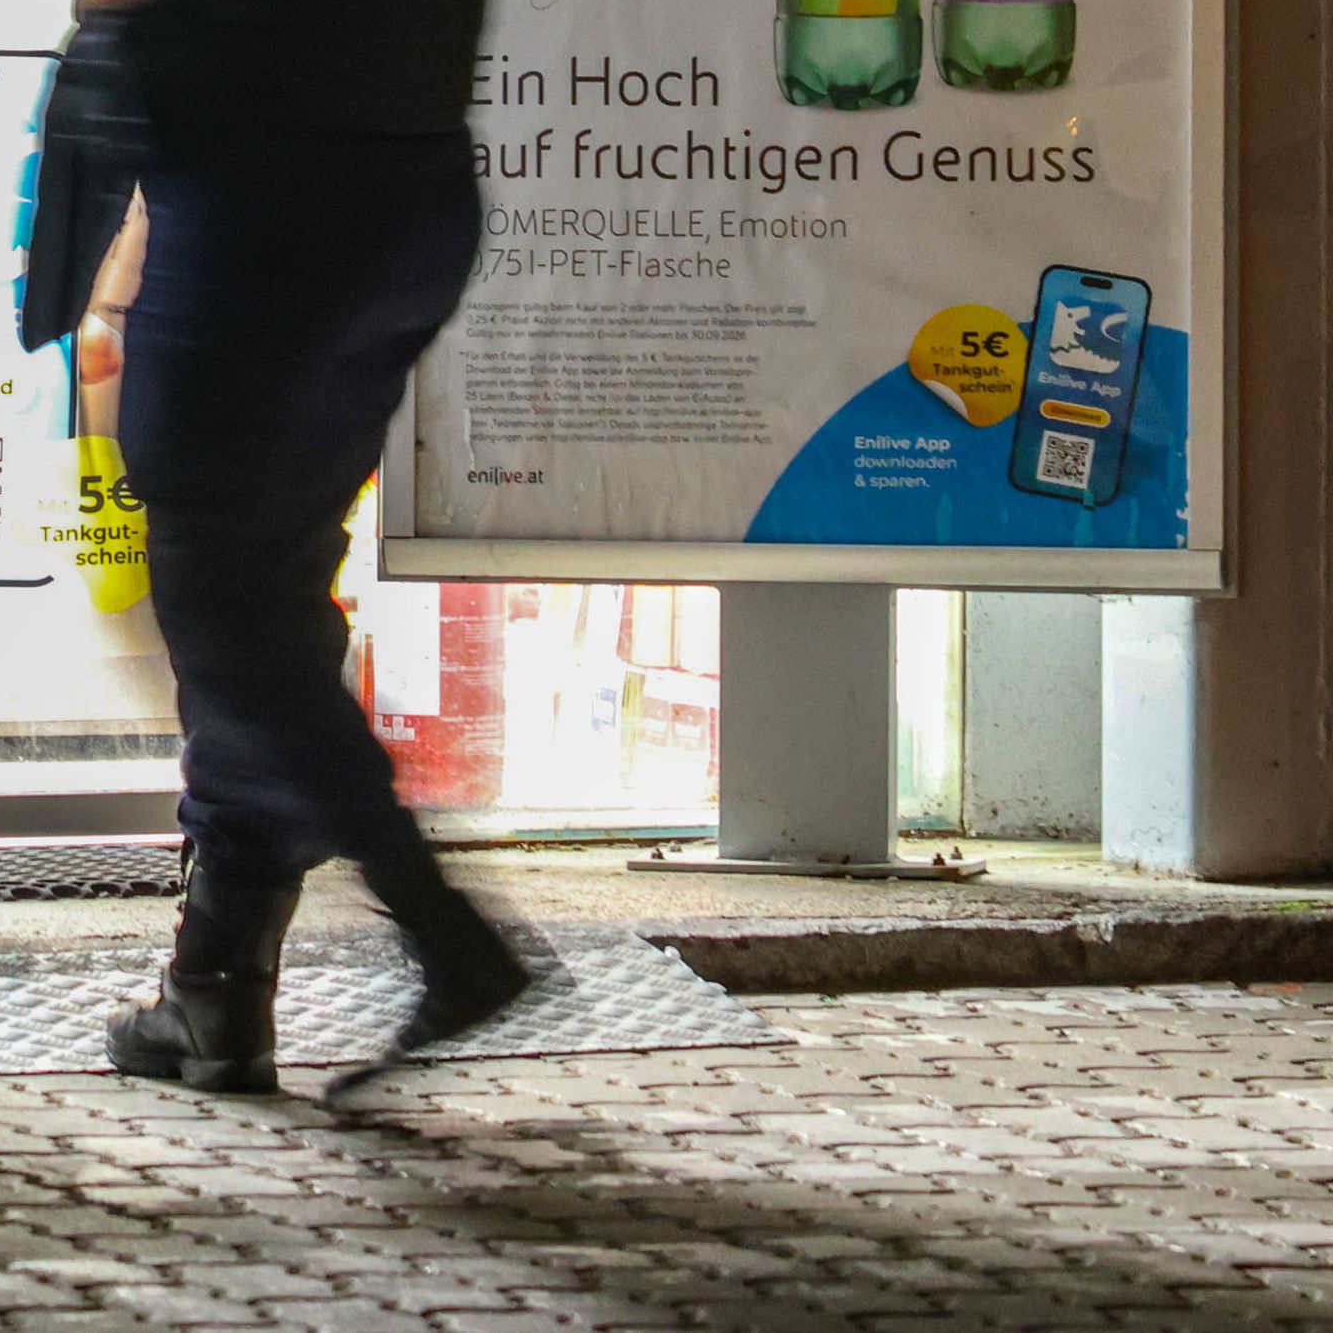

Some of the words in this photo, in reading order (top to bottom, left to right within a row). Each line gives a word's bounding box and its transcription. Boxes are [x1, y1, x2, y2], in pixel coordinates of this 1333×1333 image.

[468, 55, 544, 106] Ein
[571, 56, 719, 107] Hoch
[472, 129, 553, 179] auf
[574, 129, 858, 194] fruchtigen
[884, 130, 1096, 184] Genuss
[486, 203, 711, 245] ÖMERQUELLE,
[720, 211, 847, 238] Emotion
[961, 331, 1010, 358] 5€
[934, 364, 1004, 378] Tankgut-
[1038, 371, 1088, 390] Enilive
[1090, 379, 1122, 398] App
[854, 436, 912, 449] Enilive
[915, 437, 951, 452] App
[854, 455, 958, 469] downloaden
[854, 474, 866, 487] &
[870, 475, 930, 489] sparen.
[78, 475, 146, 514] 5€
[40, 524, 139, 545] Tankgut-
[76, 548, 147, 566] schein
